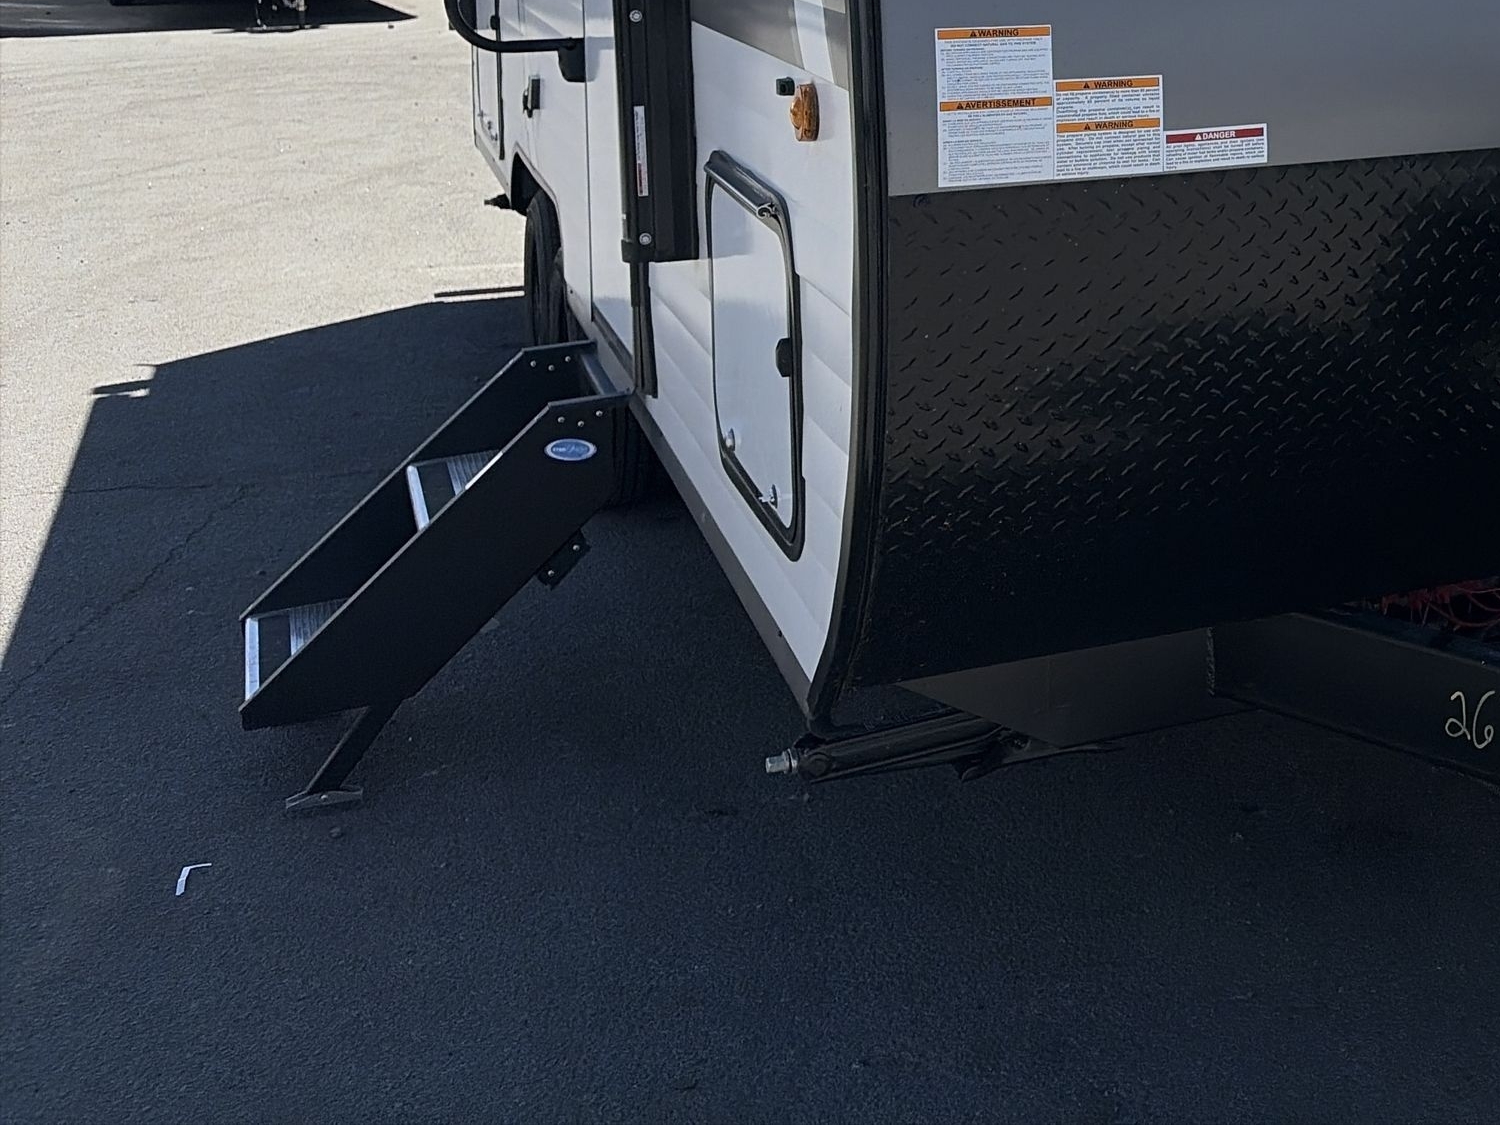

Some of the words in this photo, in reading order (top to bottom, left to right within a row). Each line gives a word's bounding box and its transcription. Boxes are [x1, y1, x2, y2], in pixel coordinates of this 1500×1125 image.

[978, 29, 1019, 38] WARNING
[1094, 79, 1133, 89] WARNING
[965, 99, 1036, 111] AVERTISSEMENT
[1095, 121, 1134, 130] WARNING
[1202, 131, 1236, 141] DANGER
